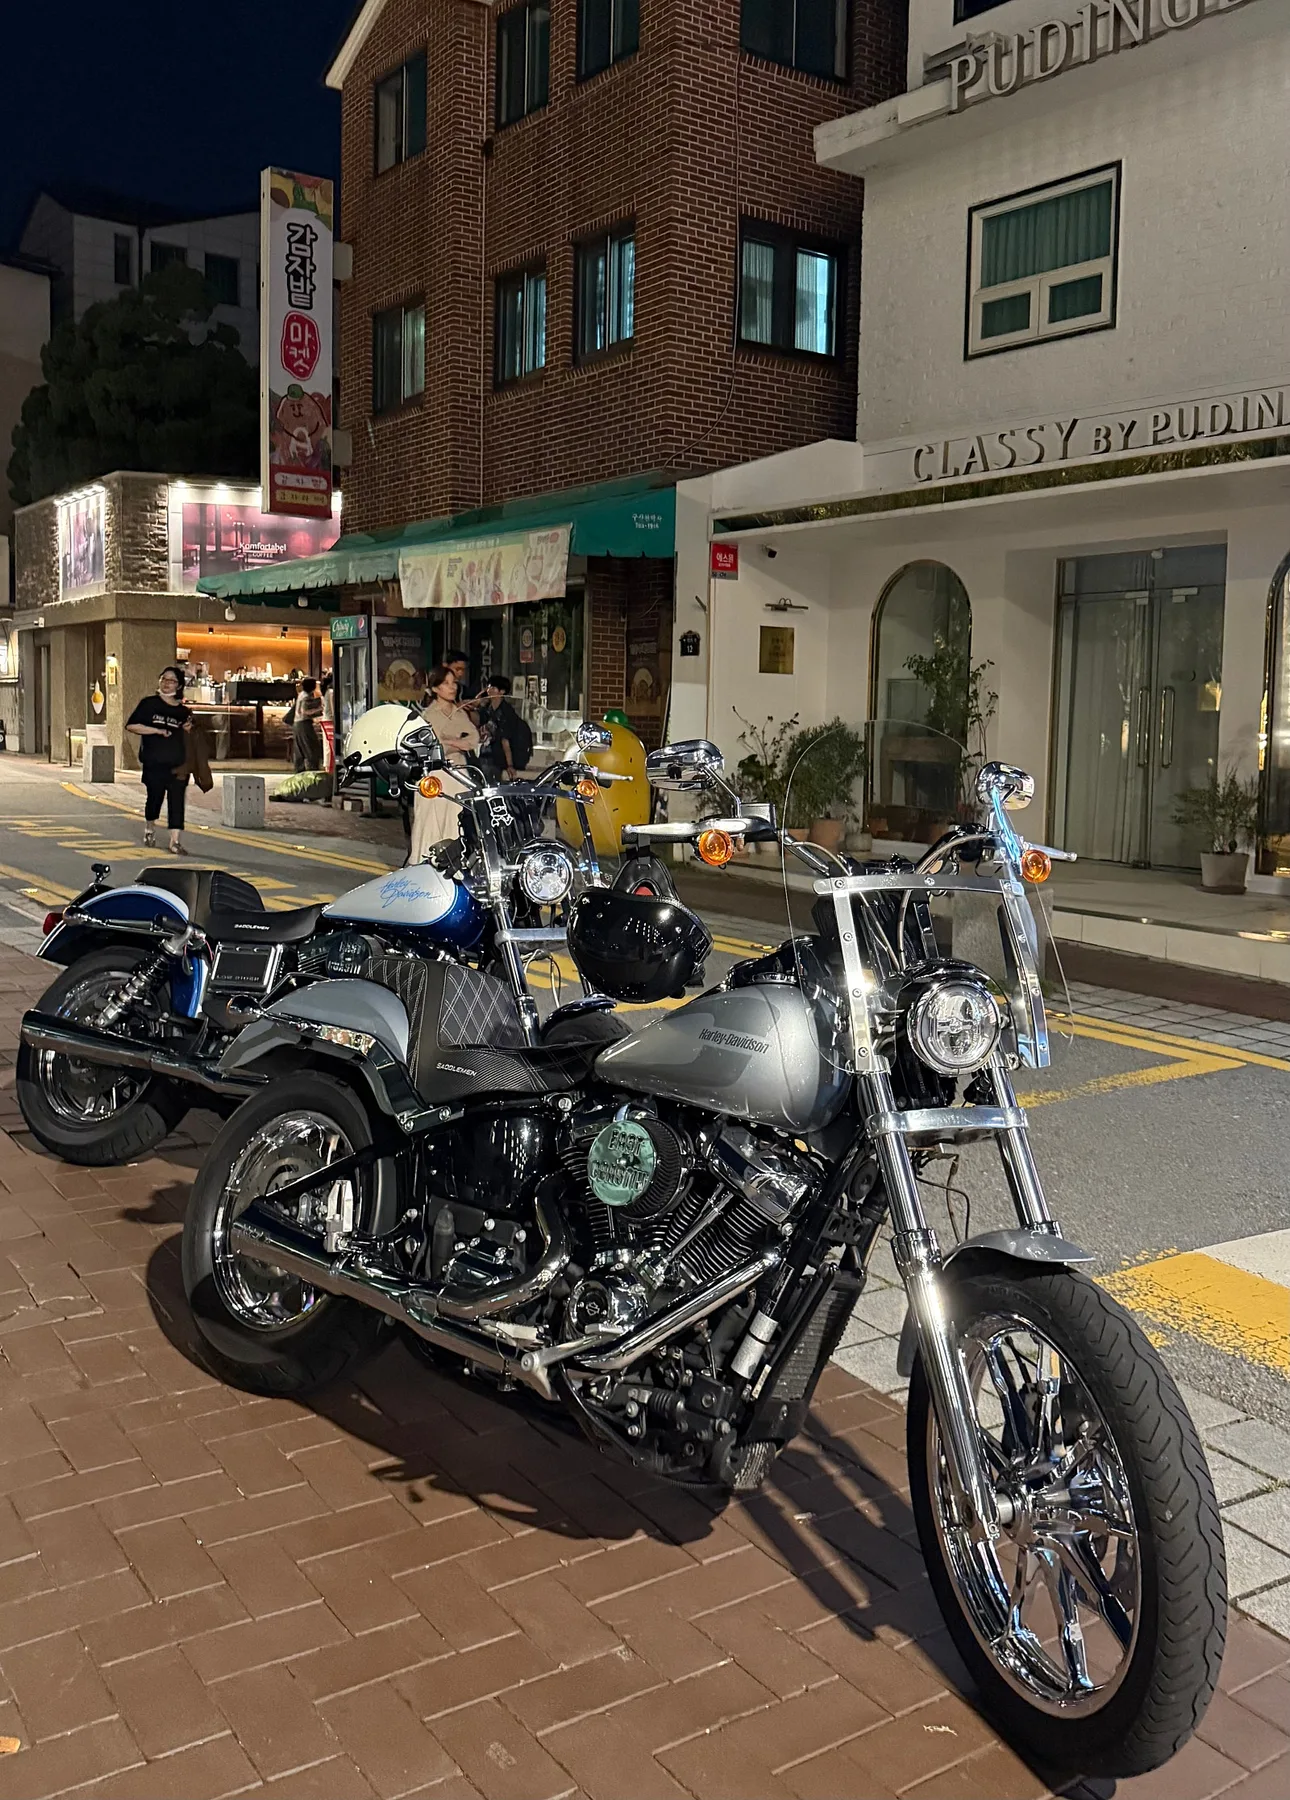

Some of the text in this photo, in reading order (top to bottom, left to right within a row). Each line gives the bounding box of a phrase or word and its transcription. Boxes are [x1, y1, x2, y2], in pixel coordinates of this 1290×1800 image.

[947, 0, 1252, 111] PUDIN
[286, 222, 318, 373] 감자밭 마켓
[913, 418, 1079, 482] CLASSY
[1090, 419, 1137, 455] BY
[240, 542, 287, 552] Komfortabel
[716, 552, 734, 564] 에스원
[234, 923, 271, 931] SADDLEMEN
[698, 1028, 770, 1054] Harley-Davidson
[436, 1062, 478, 1076] SADDLEMEN
